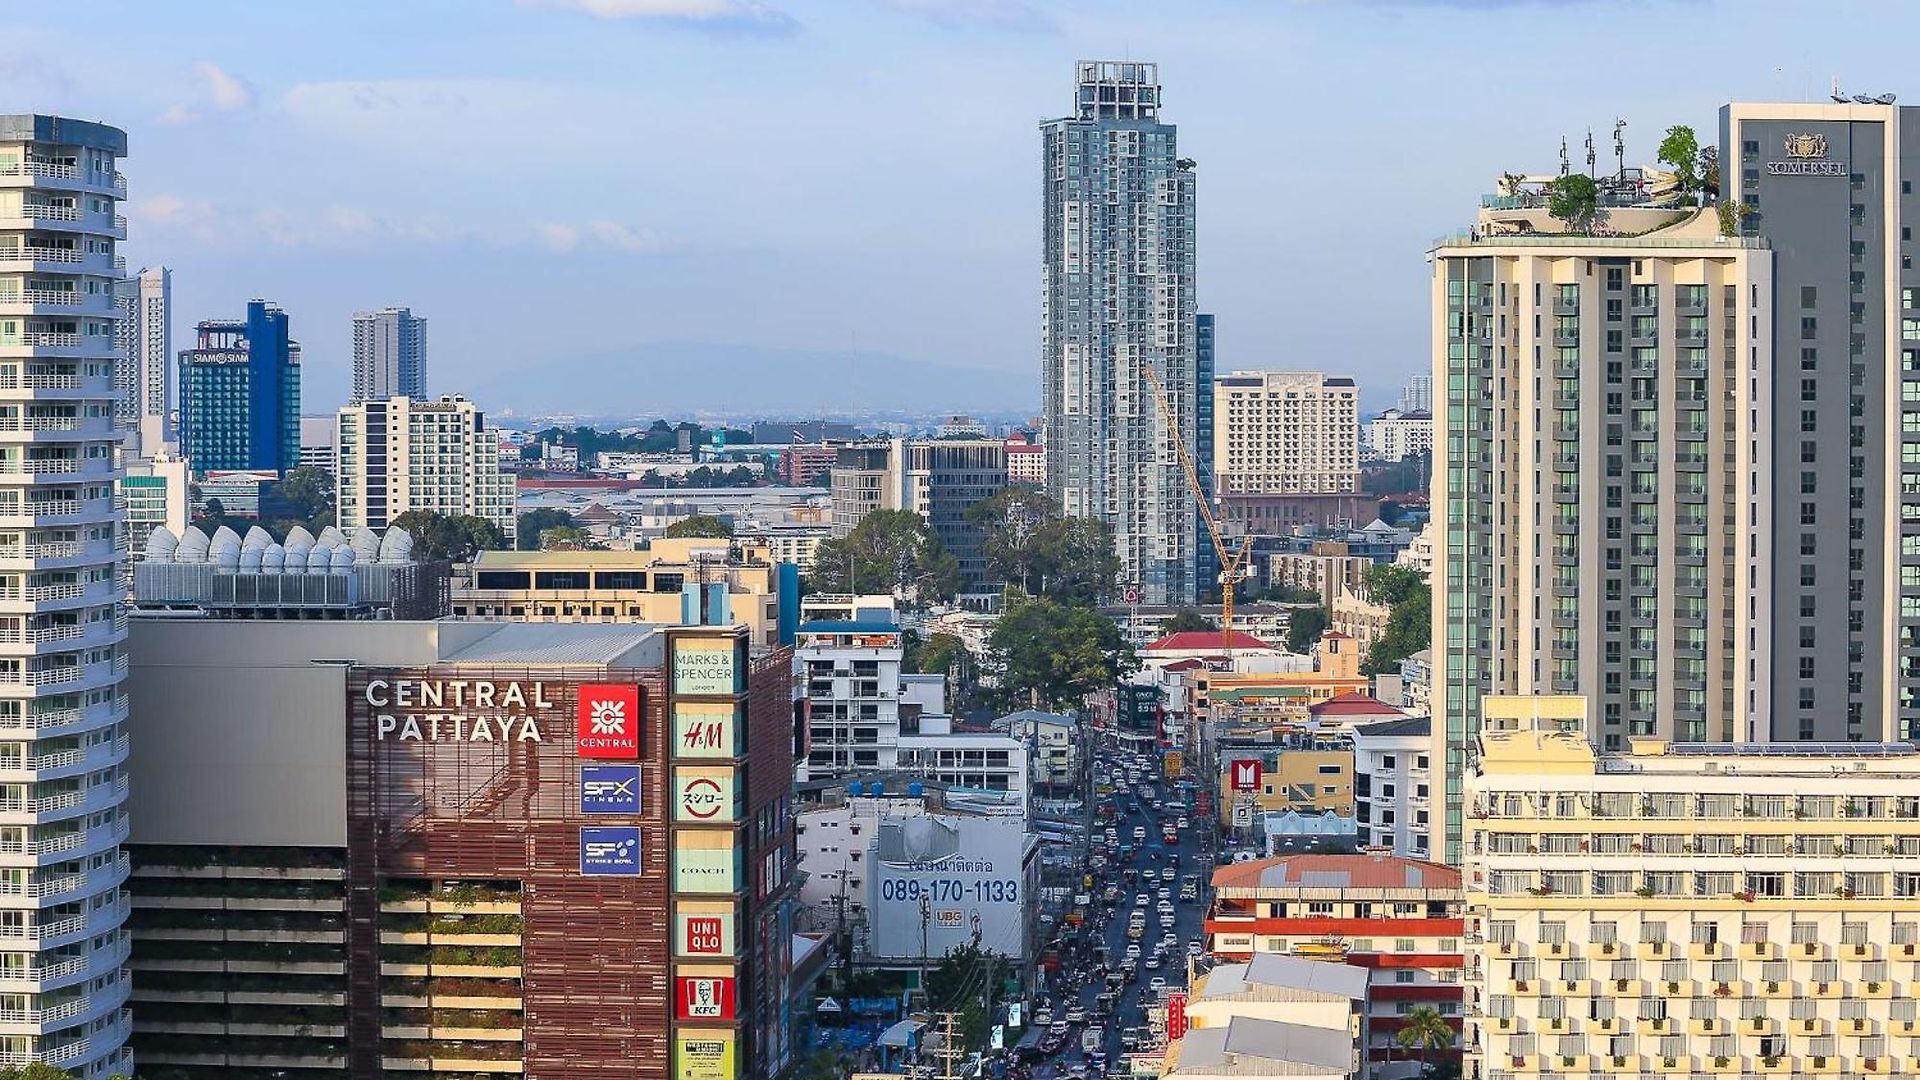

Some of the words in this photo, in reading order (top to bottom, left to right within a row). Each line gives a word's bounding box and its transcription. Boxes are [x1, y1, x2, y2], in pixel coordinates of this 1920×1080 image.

[1766, 161, 1846, 176] SOMERSET
[676, 654, 719, 665] MARKS
[721, 655, 729, 665] &
[674, 668, 732, 679] SPENCER
[365, 680, 553, 708] CENTRAL
[377, 714, 542, 742] PATTAYA
[580, 737, 636, 748] CENTRAL
[684, 722, 723, 749] H&M
[584, 777, 637, 796] SFX
[683, 793, 724, 804] スシロー
[585, 843, 616, 857] SF
[681, 867, 725, 875] COACH
[882, 879, 1018, 902] 089-170-1133
[692, 922, 716, 935] UNI
[692, 936, 719, 950] QLO
[694, 1006, 717, 1015] KFC
